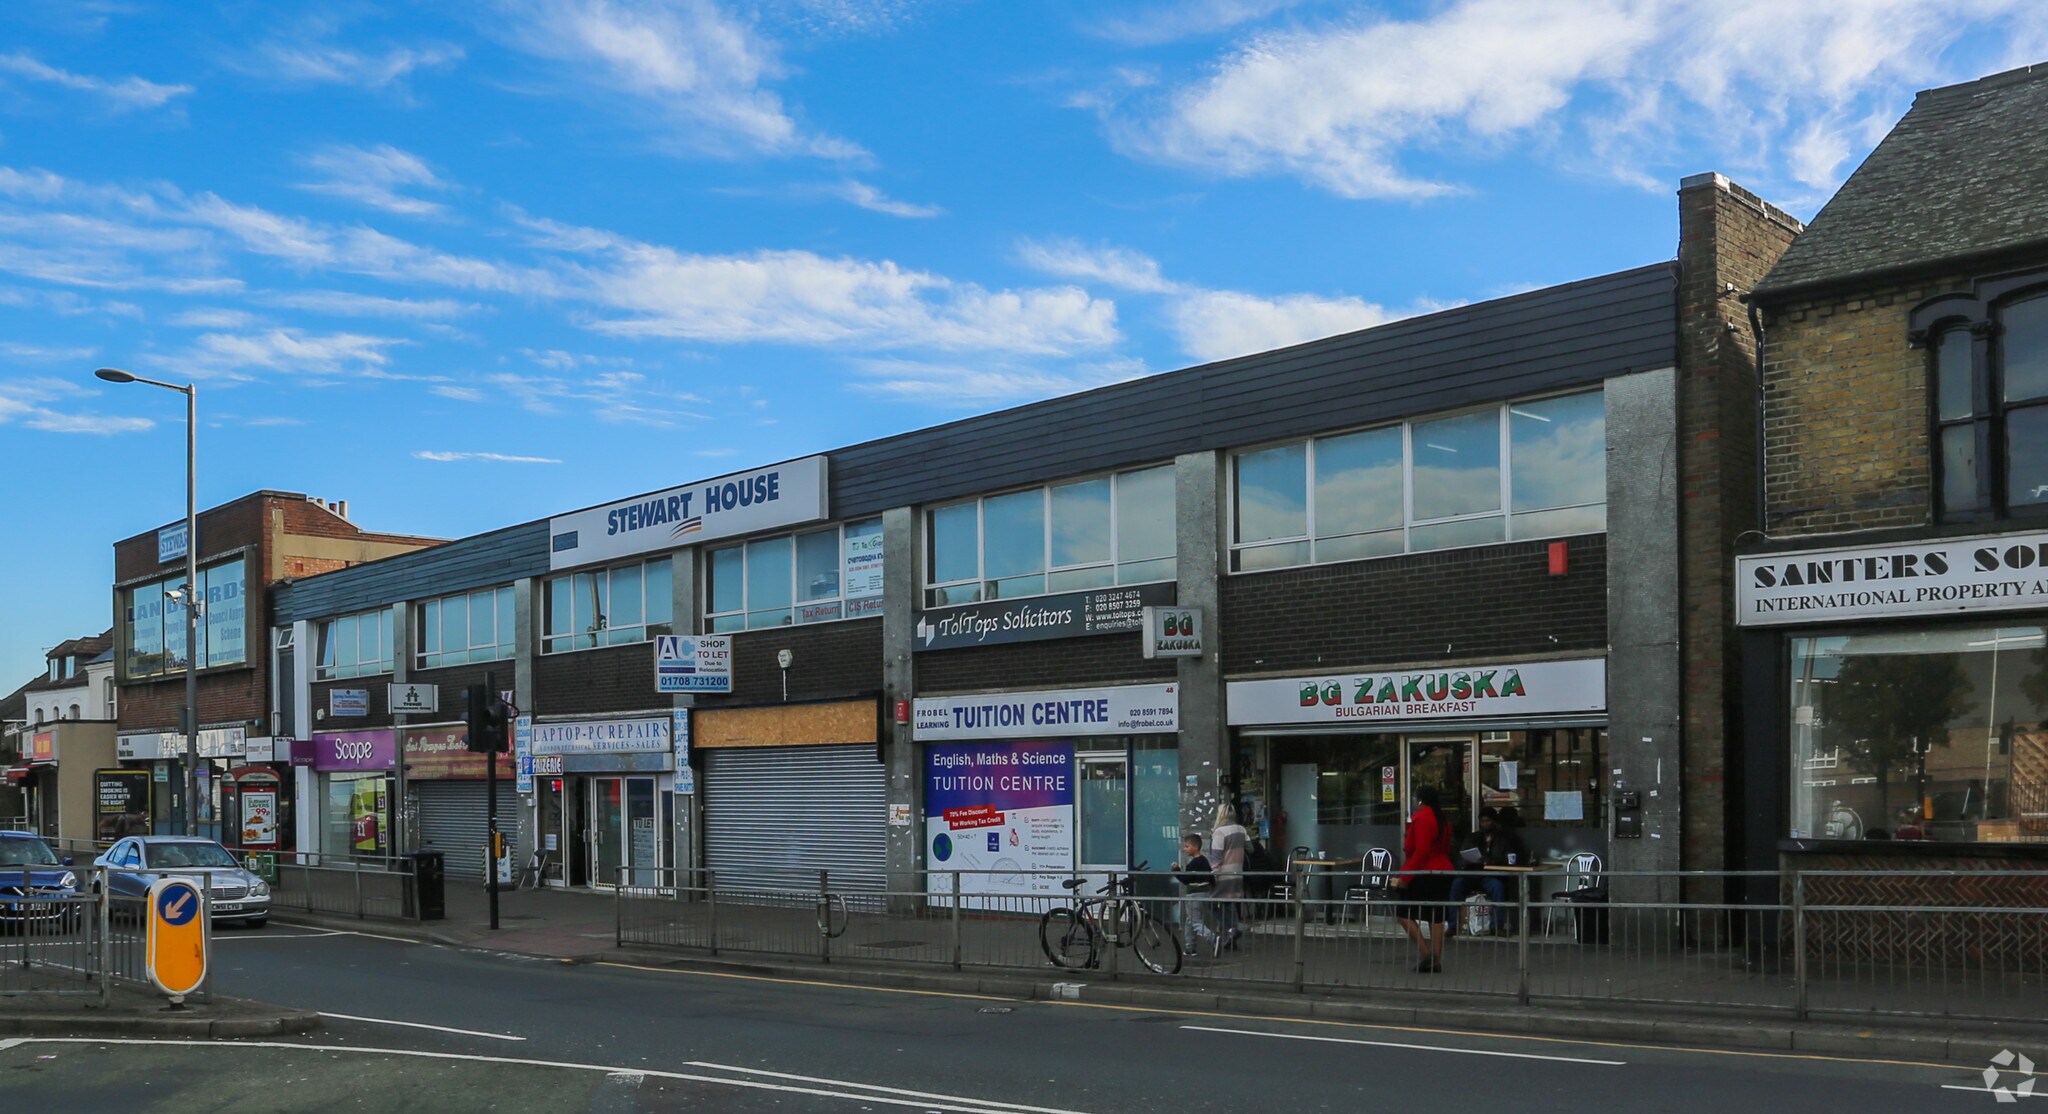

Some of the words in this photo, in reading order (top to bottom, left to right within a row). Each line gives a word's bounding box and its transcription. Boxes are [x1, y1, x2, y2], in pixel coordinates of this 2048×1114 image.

[607, 492, 693, 536] STEWART
[706, 472, 779, 515] HOUSE
[1754, 551, 1949, 589] SANTERS
[1095, 594, 1107, 602] 020
[1108, 592, 1123, 601] 3247
[1124, 590, 1140, 600] 4674
[1755, 588, 1911, 613] INTERNATIONAL
[1916, 580, 2027, 601] PROPERTY
[2031, 579, 2048, 595] A
[802, 609, 814, 618] Tax
[848, 601, 861, 612] CIS
[1095, 603, 1107, 612] 020
[1108, 601, 1124, 610] 8507
[1125, 599, 1141, 608] 3259
[1003, 604, 1072, 630] Solicitors
[1163, 612, 1194, 636] BG
[658, 636, 696, 659] AC
[700, 640, 726, 648] SHOP
[1157, 640, 1201, 650] ZAKUSKA
[661, 677, 690, 686] 01708
[693, 677, 728, 686] 731200
[1299, 679, 1342, 707] BG
[1354, 668, 1527, 705] ZAKUSKA
[916, 709, 949, 717] FROBEL
[953, 703, 1025, 729] TUITION
[1032, 699, 1109, 725] CENTRE
[1129, 708, 1141, 716] 020
[1142, 707, 1157, 716] 8591
[1158, 707, 1174, 715] 7894
[1335, 704, 1400, 718] BULGARIAN
[1406, 701, 1477, 715] BREAKFAST
[608, 721, 669, 739] REPAIRS
[916, 720, 950, 729] LEARNING
[1118, 717, 1174, 730] info@frobel.co.uk
[335, 738, 373, 764] Scope
[934, 753, 974, 769] English,
[976, 752, 1008, 765] Maths
[1011, 753, 1019, 765] &
[1022, 751, 1066, 765] Science
[934, 775, 994, 791] TUITION
[1000, 775, 1066, 791] CENTRE
[255, 807, 271, 816] 99p
[967, 808, 988, 816] Discount
[634, 818, 643, 828] TO
[644, 818, 654, 829] LET
